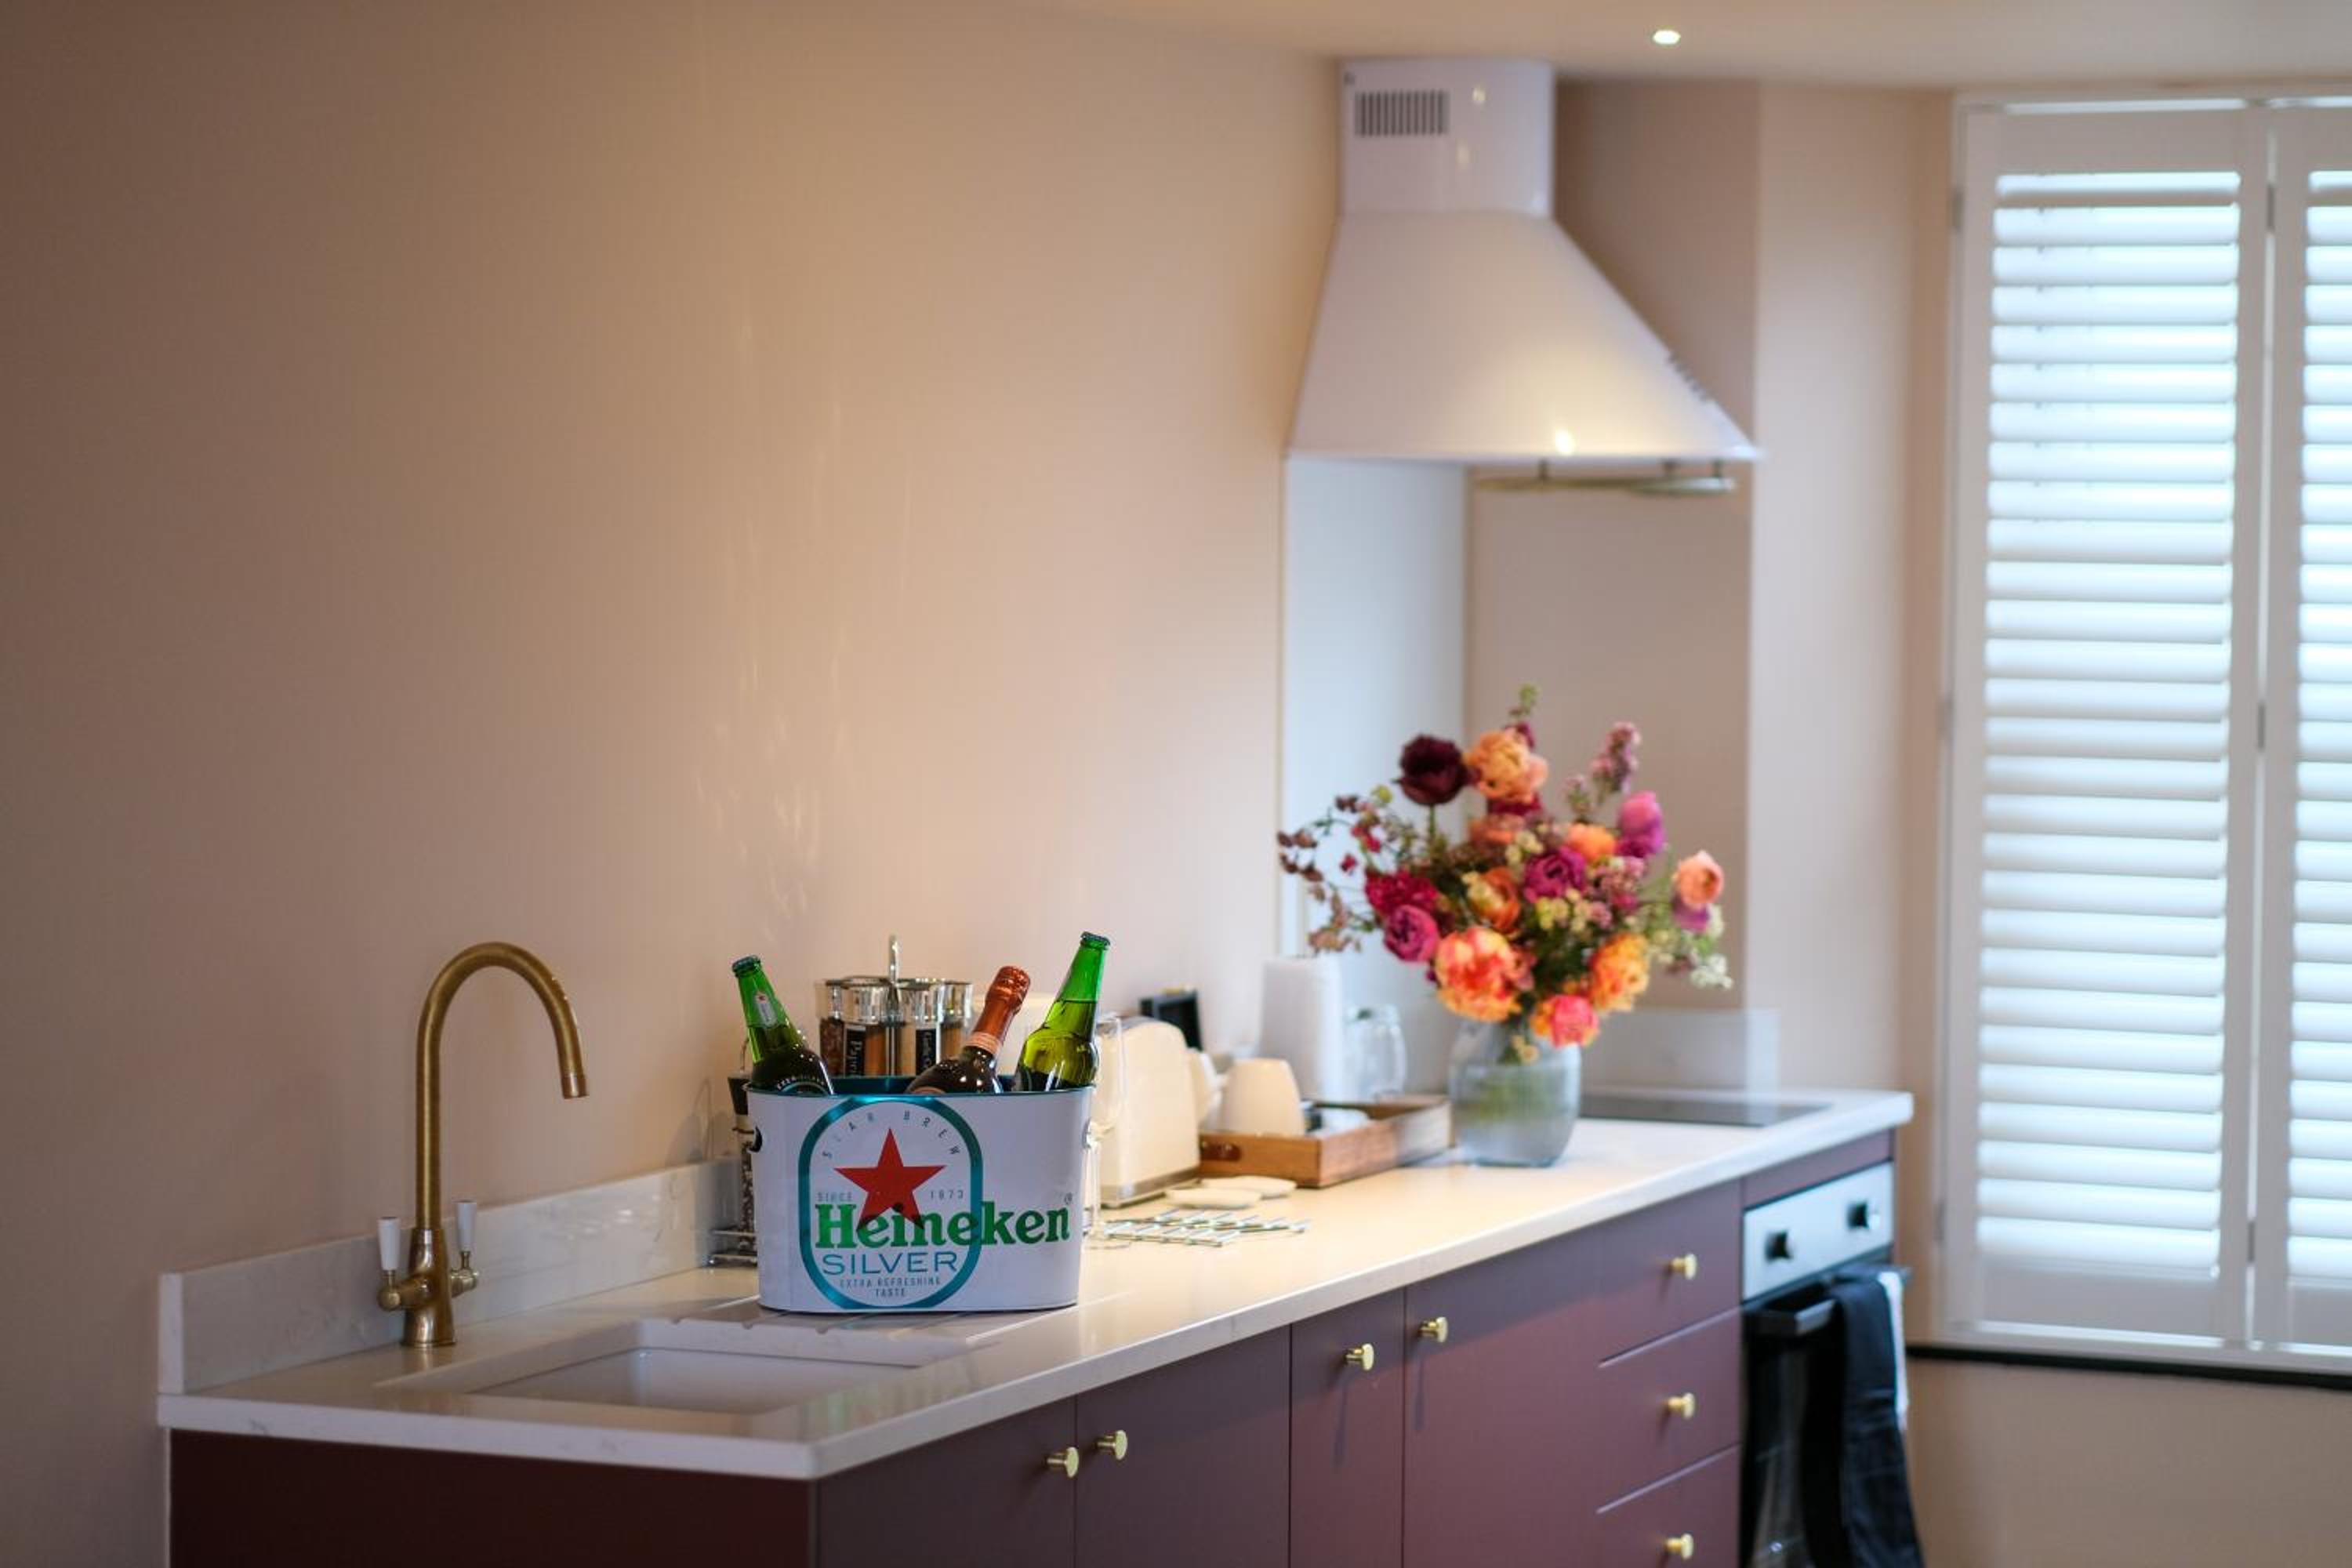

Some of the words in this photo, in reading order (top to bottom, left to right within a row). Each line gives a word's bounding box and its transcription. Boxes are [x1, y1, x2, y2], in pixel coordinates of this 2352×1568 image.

[904, 1110, 960, 1156] BREW
[815, 1200, 1070, 1249] Heineken
[822, 1250, 958, 1276] SILVER
[840, 1279, 873, 1288] EXTRA
[877, 1276, 941, 1287] REFRESHING
[875, 1287, 906, 1298] TASTE
